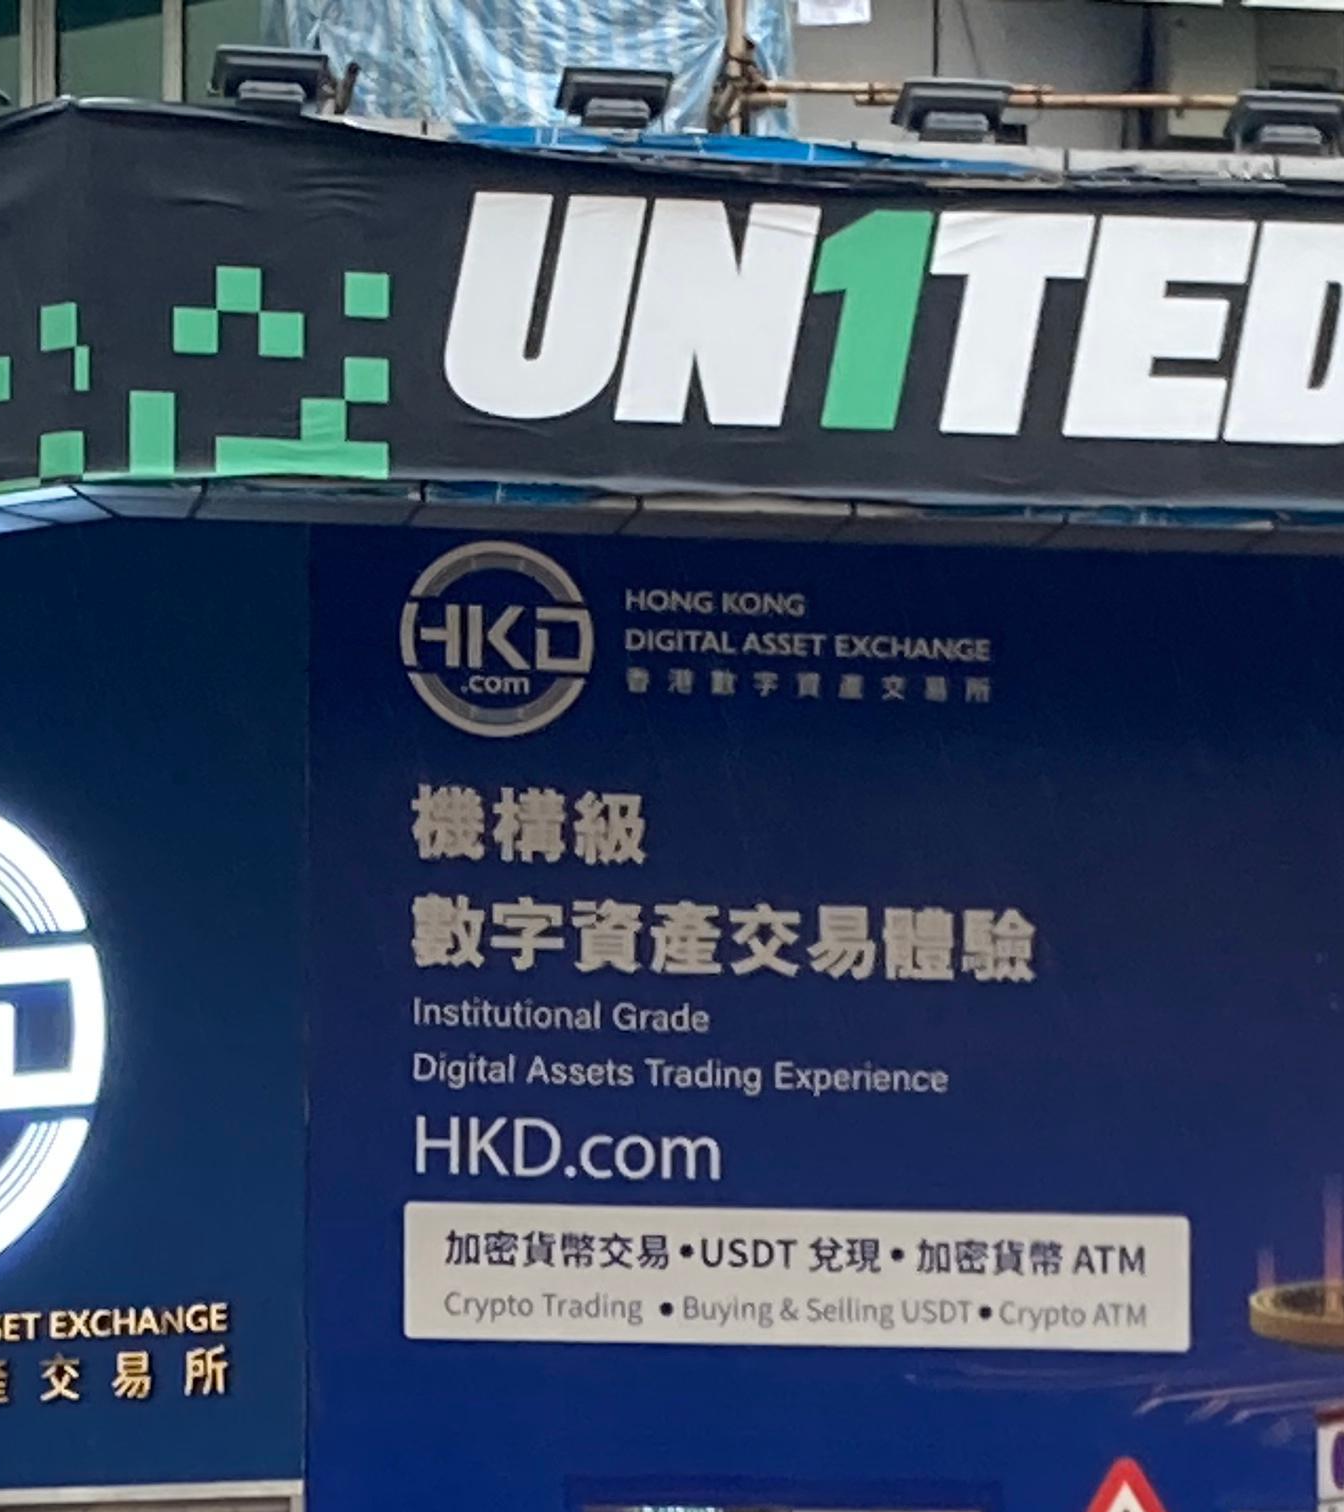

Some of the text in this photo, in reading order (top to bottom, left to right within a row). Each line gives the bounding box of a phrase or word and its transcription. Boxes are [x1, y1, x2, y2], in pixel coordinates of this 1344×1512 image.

[625, 588, 806, 617] HONG KONG
[400, 603, 594, 671] HKD
[625, 629, 990, 662] DIGITAL ASSET EXCHANGE
[411, 784, 648, 865] 機構級
[411, 893, 1037, 982] 數字資產交易體驗
[412, 997, 710, 1034] Institutional Grade
[412, 1053, 949, 1097] Digital Assets Trading Experience
[414, 1115, 722, 1182] HKD.com
[700, 1237, 798, 1269] USDT
[1072, 1246, 1146, 1274] ATM
[50, 1302, 229, 1338] EXCHANGE
[444, 1292, 1147, 1332] Crypto Trading Buying & Selling USDT Crypto ATM
